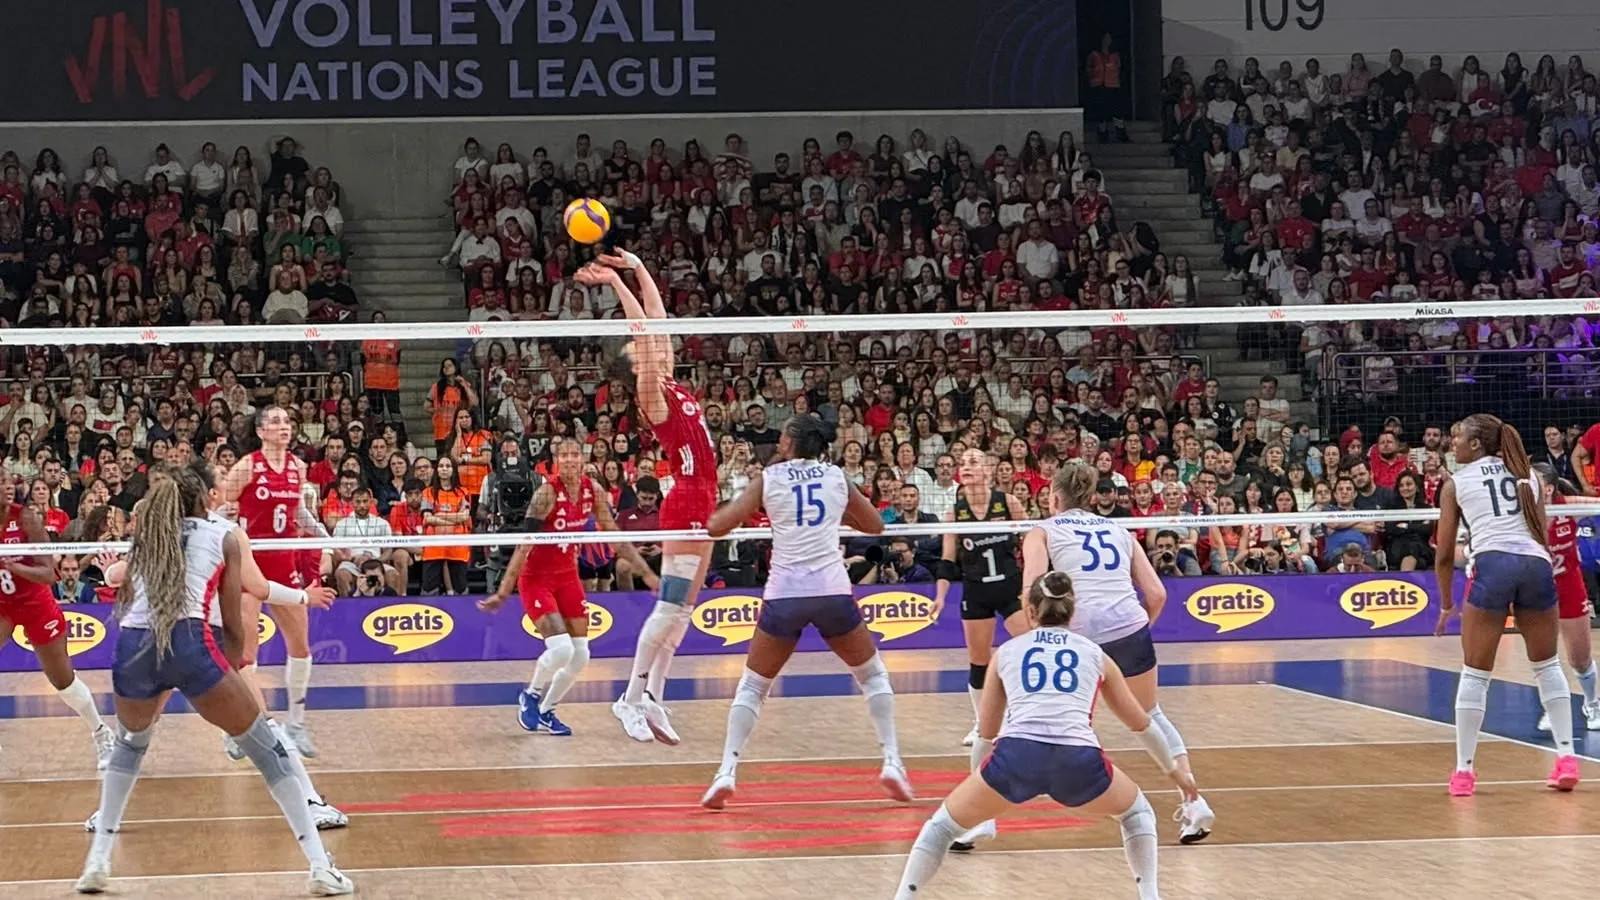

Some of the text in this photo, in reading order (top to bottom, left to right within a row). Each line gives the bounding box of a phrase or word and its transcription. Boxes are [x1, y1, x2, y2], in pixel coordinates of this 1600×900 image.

[240, 0, 716, 48] VOLLEYBALL
[1245, 0, 1325, 31] 109
[242, 57, 717, 101] NATIONS LEAGUE
[788, 467, 825, 481] SYLVES
[792, 483, 826, 527] 15
[1483, 477, 1522, 517] 19
[273, 503, 287, 533] 6
[982, 549, 1006, 583] 1
[1073, 530, 1120, 572] 35
[862, 597, 930, 624] gratis
[1197, 589, 1265, 616] gratis
[1350, 585, 1418, 612] gratis
[373, 609, 444, 637] gratis
[702, 601, 759, 629] grati
[1033, 631, 1068, 645] JAEGY
[1021, 647, 1079, 693] 68
